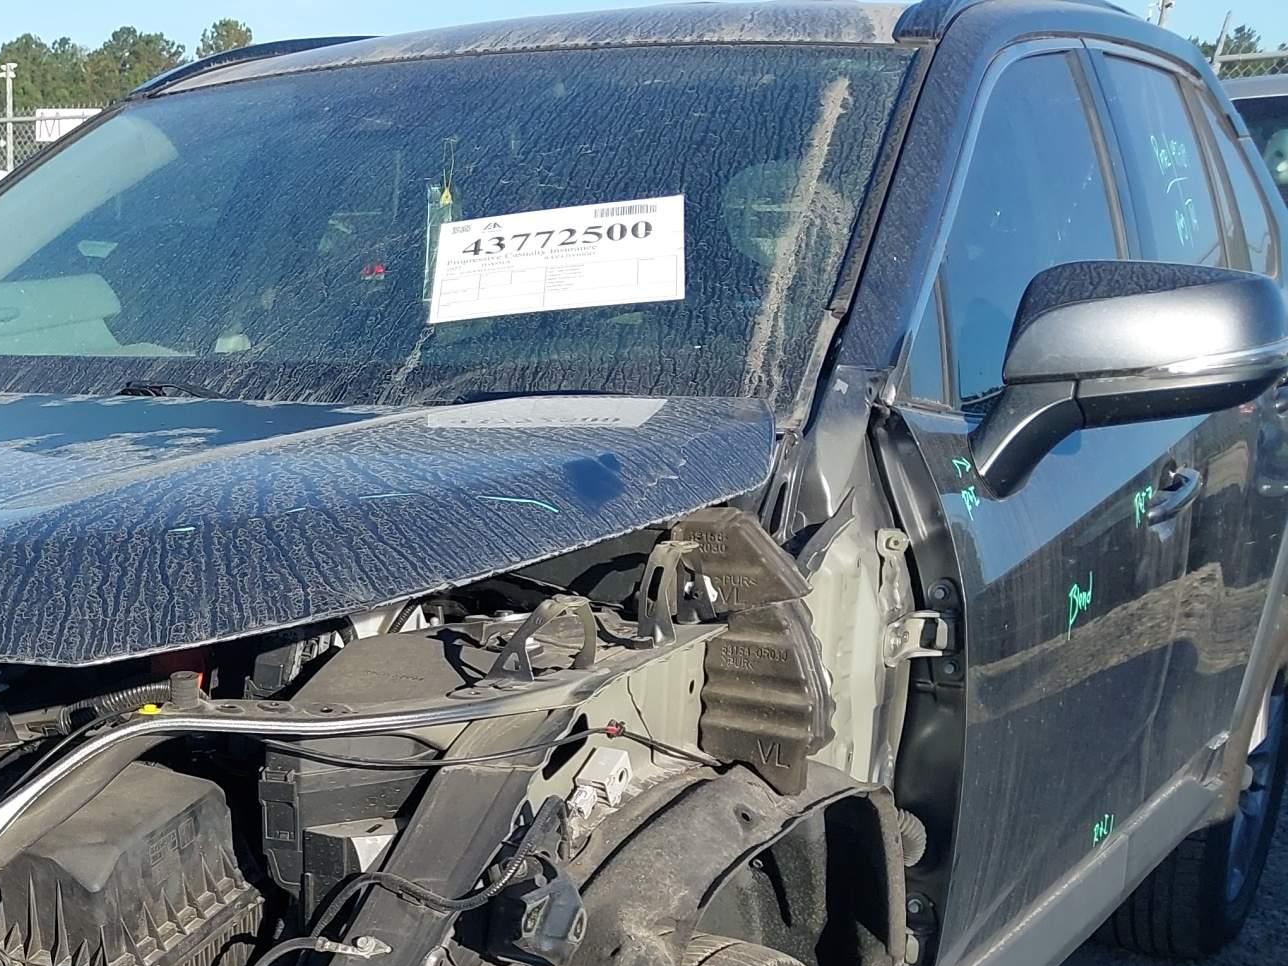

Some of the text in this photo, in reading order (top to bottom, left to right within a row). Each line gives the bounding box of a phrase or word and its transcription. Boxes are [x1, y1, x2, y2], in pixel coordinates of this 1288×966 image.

[462, 221, 652, 256] 43772500
[717, 586, 746, 605] VL
[757, 739, 791, 769] VL
